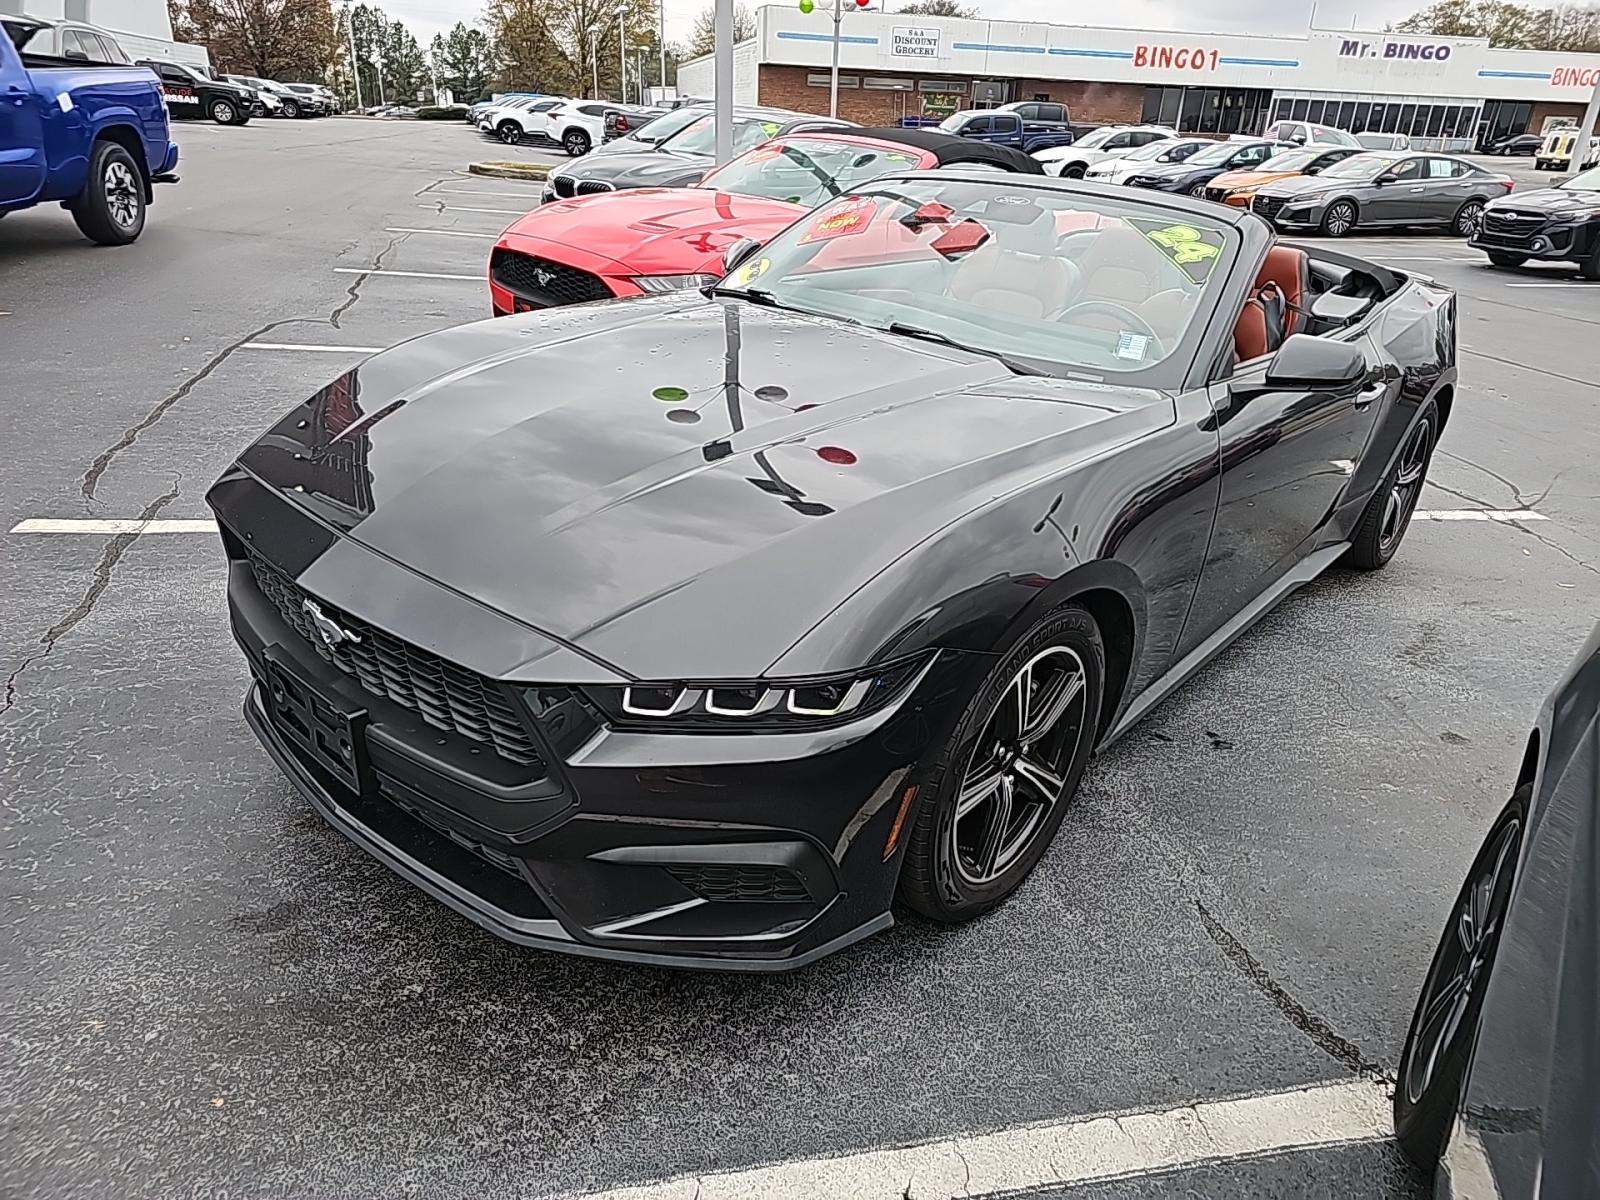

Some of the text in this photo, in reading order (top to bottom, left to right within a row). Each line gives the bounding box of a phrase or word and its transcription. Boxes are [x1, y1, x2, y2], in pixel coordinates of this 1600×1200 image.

[1339, 40, 1451, 61] Mr. BINGO
[1146, 224, 1220, 264] 24
[1032, 619, 1068, 647] SPORT
